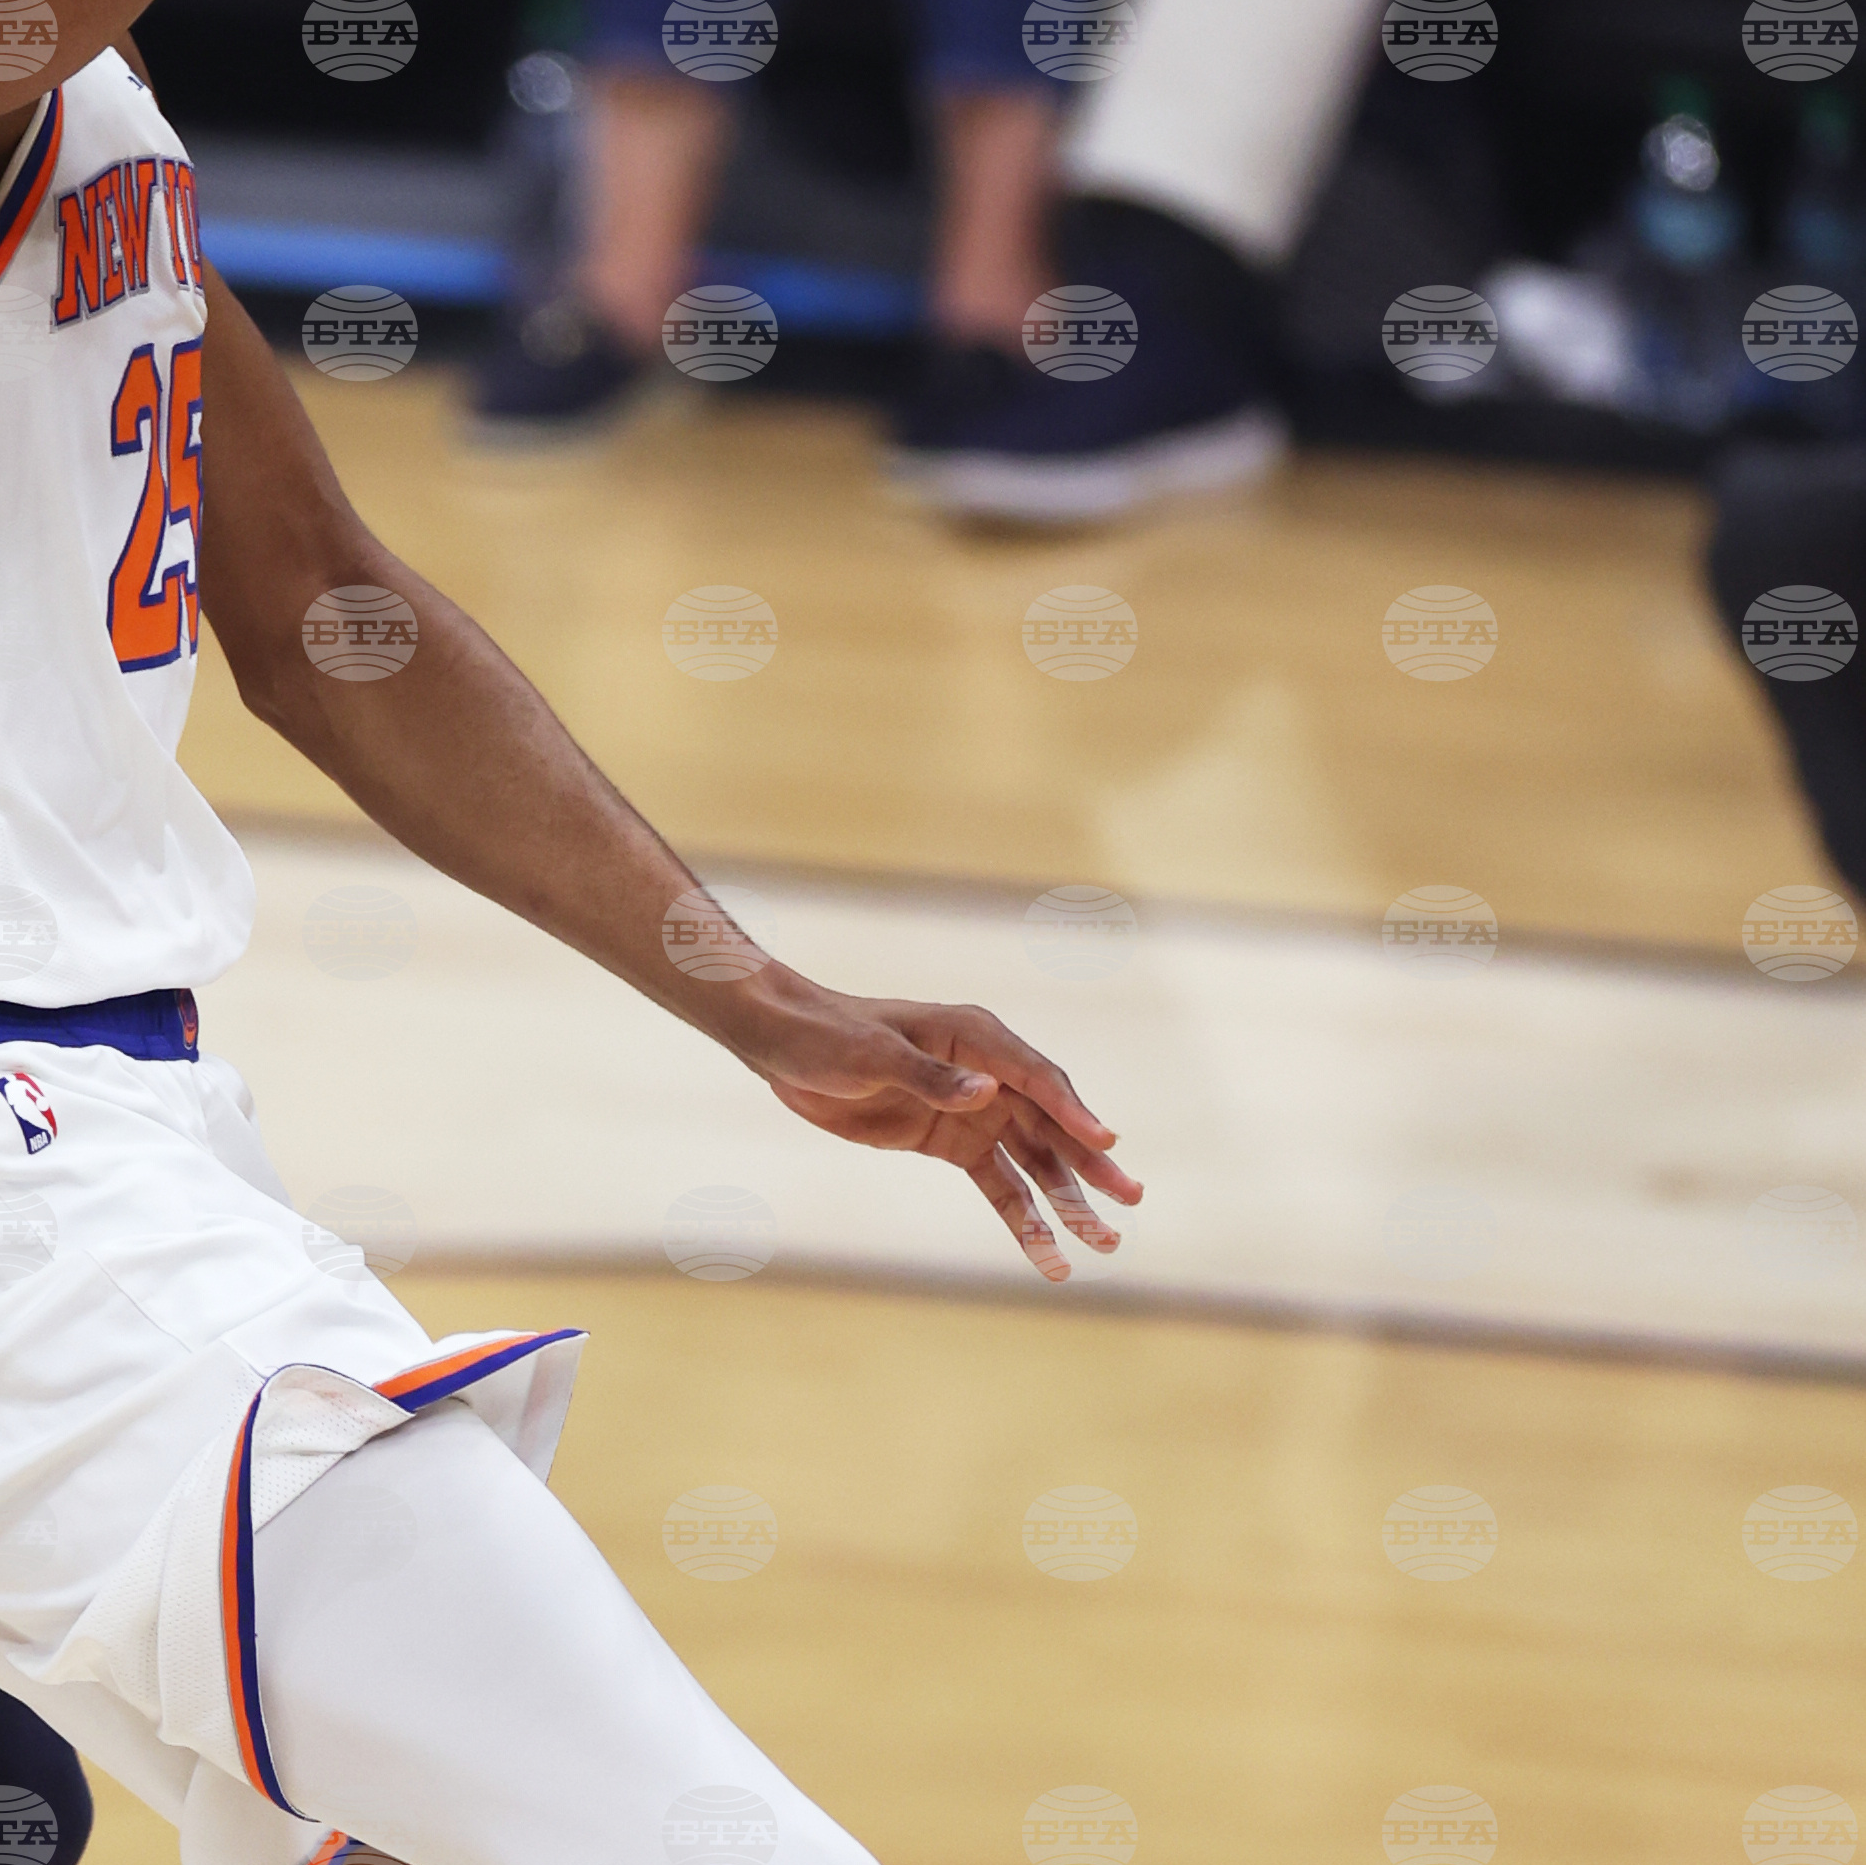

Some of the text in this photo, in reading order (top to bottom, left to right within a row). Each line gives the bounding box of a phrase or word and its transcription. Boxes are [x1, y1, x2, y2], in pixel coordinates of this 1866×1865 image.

[50, 152, 161, 334] NEW
[107, 341, 206, 672] 25
[29, 1131, 50, 1153] NBA
